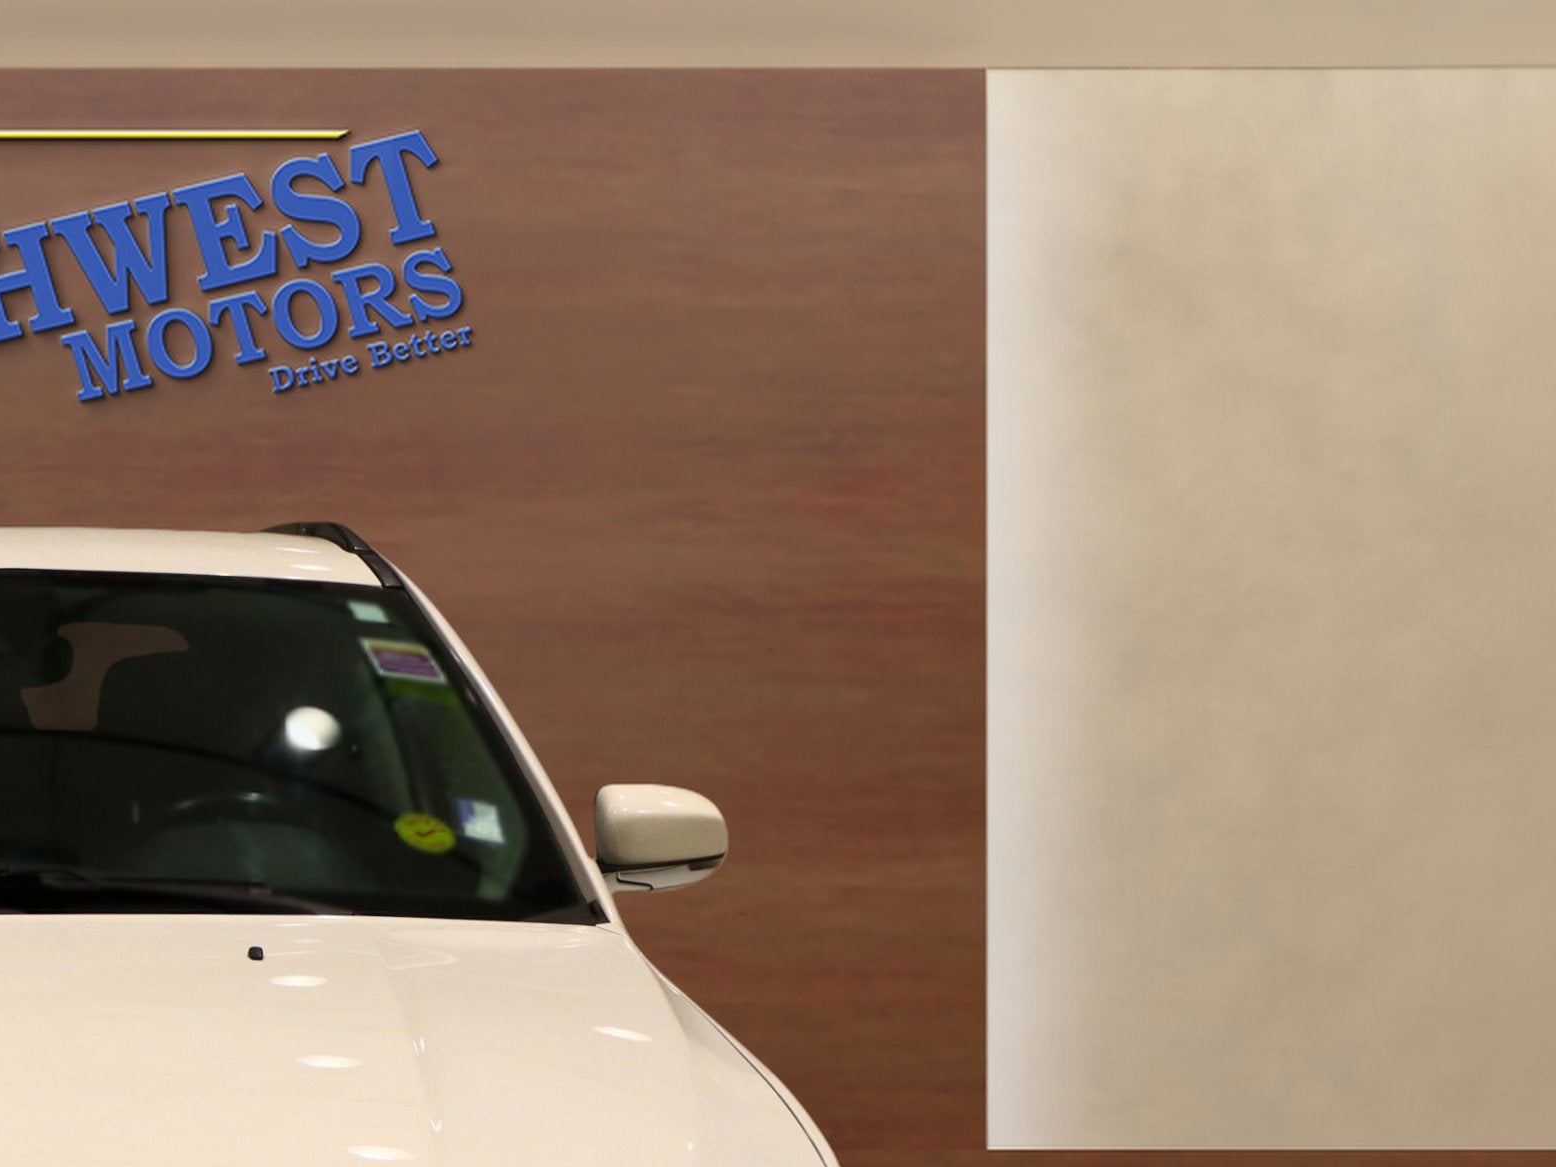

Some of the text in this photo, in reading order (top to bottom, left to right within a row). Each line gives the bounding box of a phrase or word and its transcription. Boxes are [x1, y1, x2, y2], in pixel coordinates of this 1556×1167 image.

[61, 246, 463, 402] MOTORS
[268, 325, 473, 393] Drive Better
